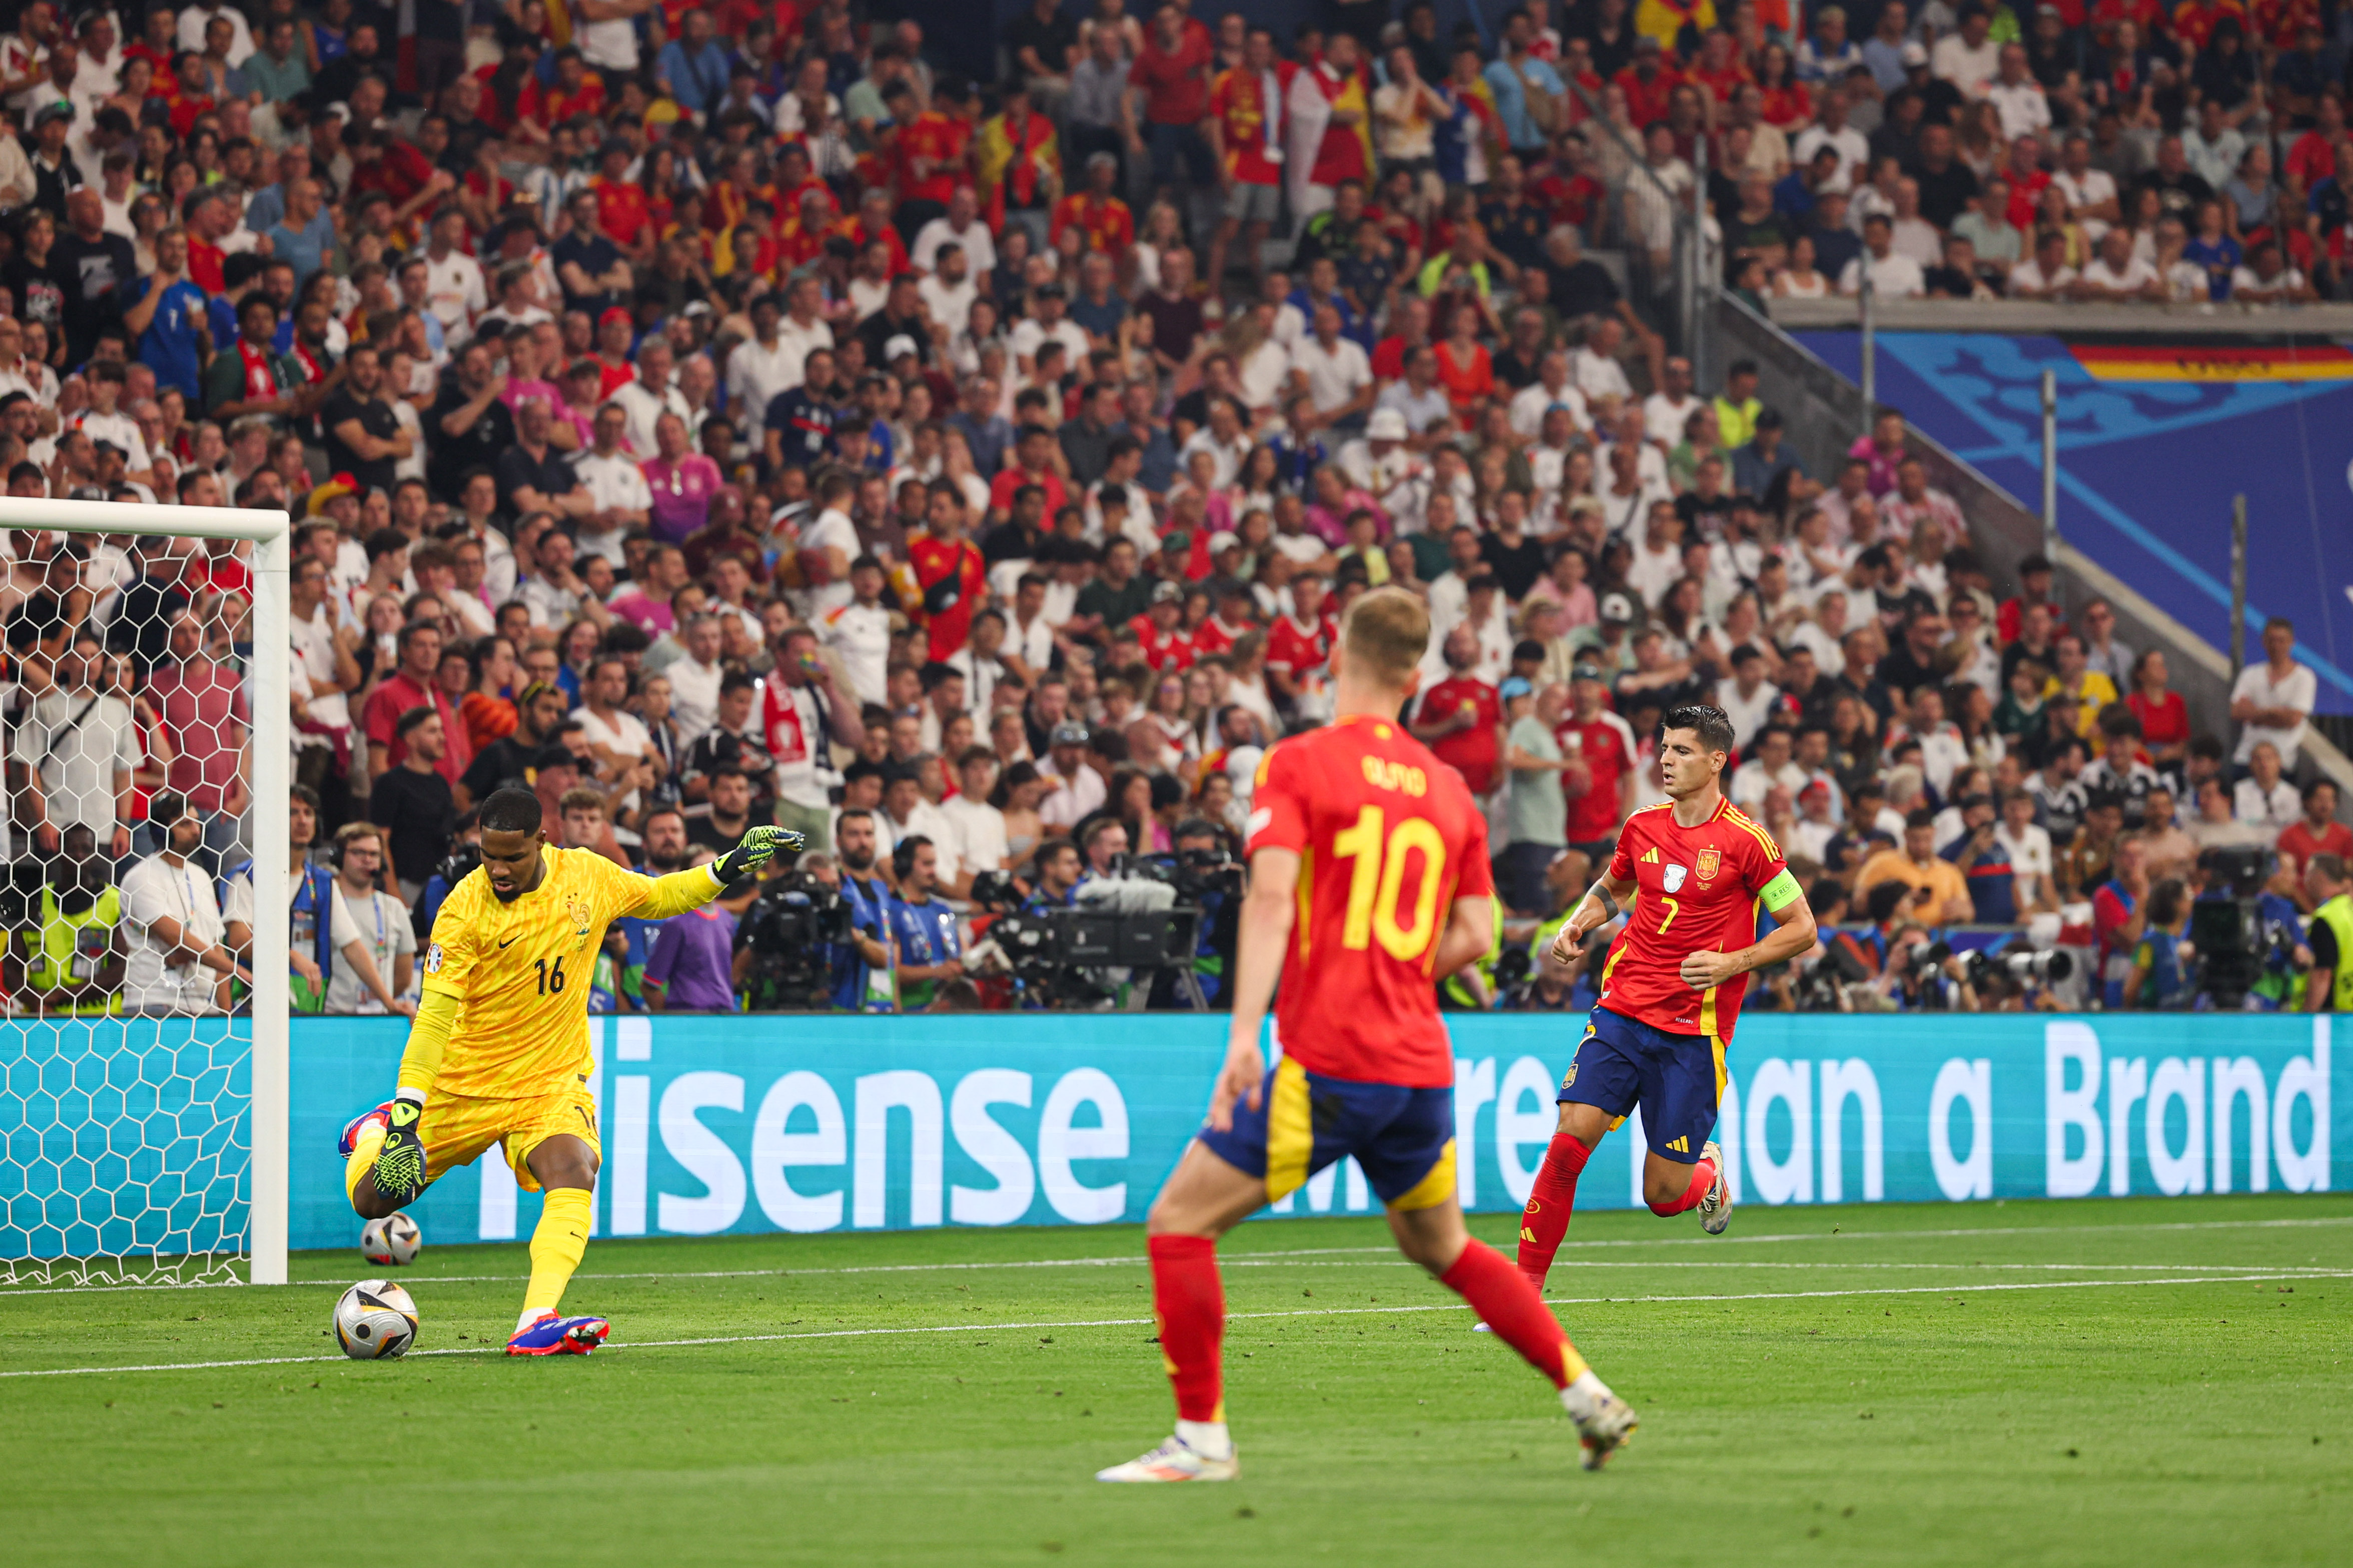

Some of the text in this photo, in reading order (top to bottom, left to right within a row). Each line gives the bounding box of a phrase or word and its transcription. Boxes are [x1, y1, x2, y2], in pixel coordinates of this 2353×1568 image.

[747, 849, 774, 861] uhlsport
[1333, 804, 1446, 962] 10
[1657, 897, 1679, 935] 7
[534, 956, 565, 996] 16
[1928, 1057, 1992, 1201] a
[2045, 1014, 2331, 1197] Brand
